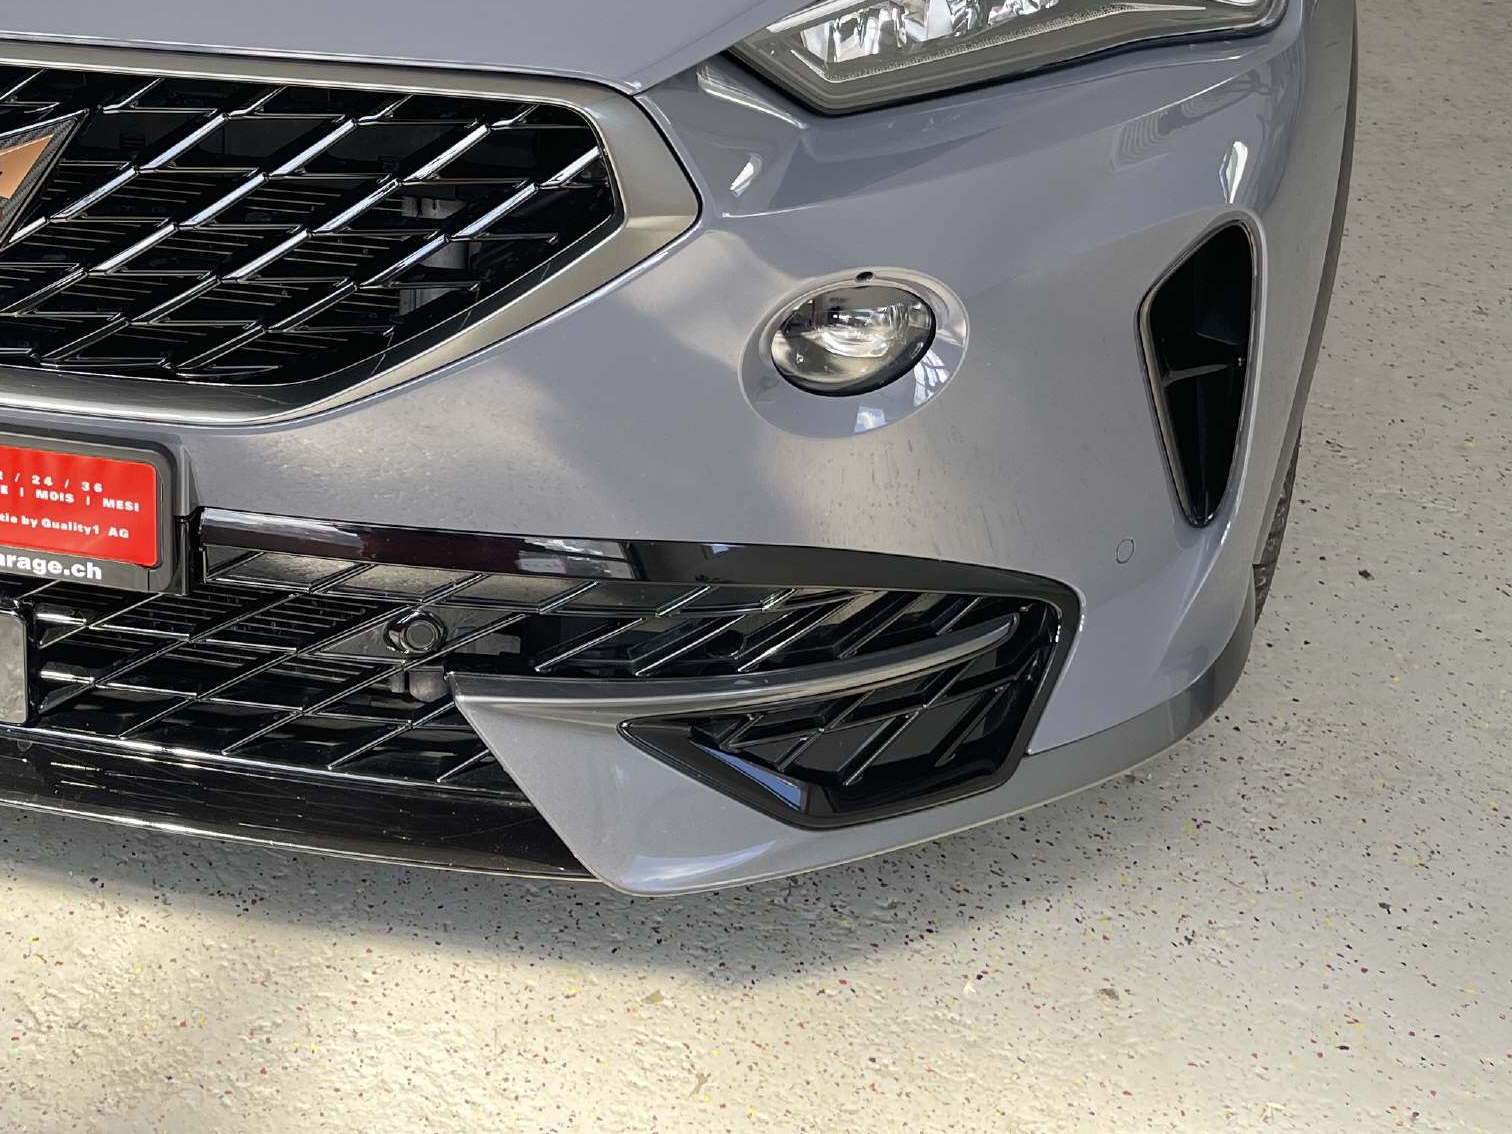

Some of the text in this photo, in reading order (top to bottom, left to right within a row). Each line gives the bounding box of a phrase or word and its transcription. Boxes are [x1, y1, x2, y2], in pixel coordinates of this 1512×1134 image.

[31, 474, 54, 487] 24
[81, 481, 103, 493] 36
[35, 489, 75, 504] MOIS
[102, 497, 140, 513] MESI
[21, 514, 39, 528] by
[41, 517, 100, 536] Quality1
[108, 526, 129, 539] AG
